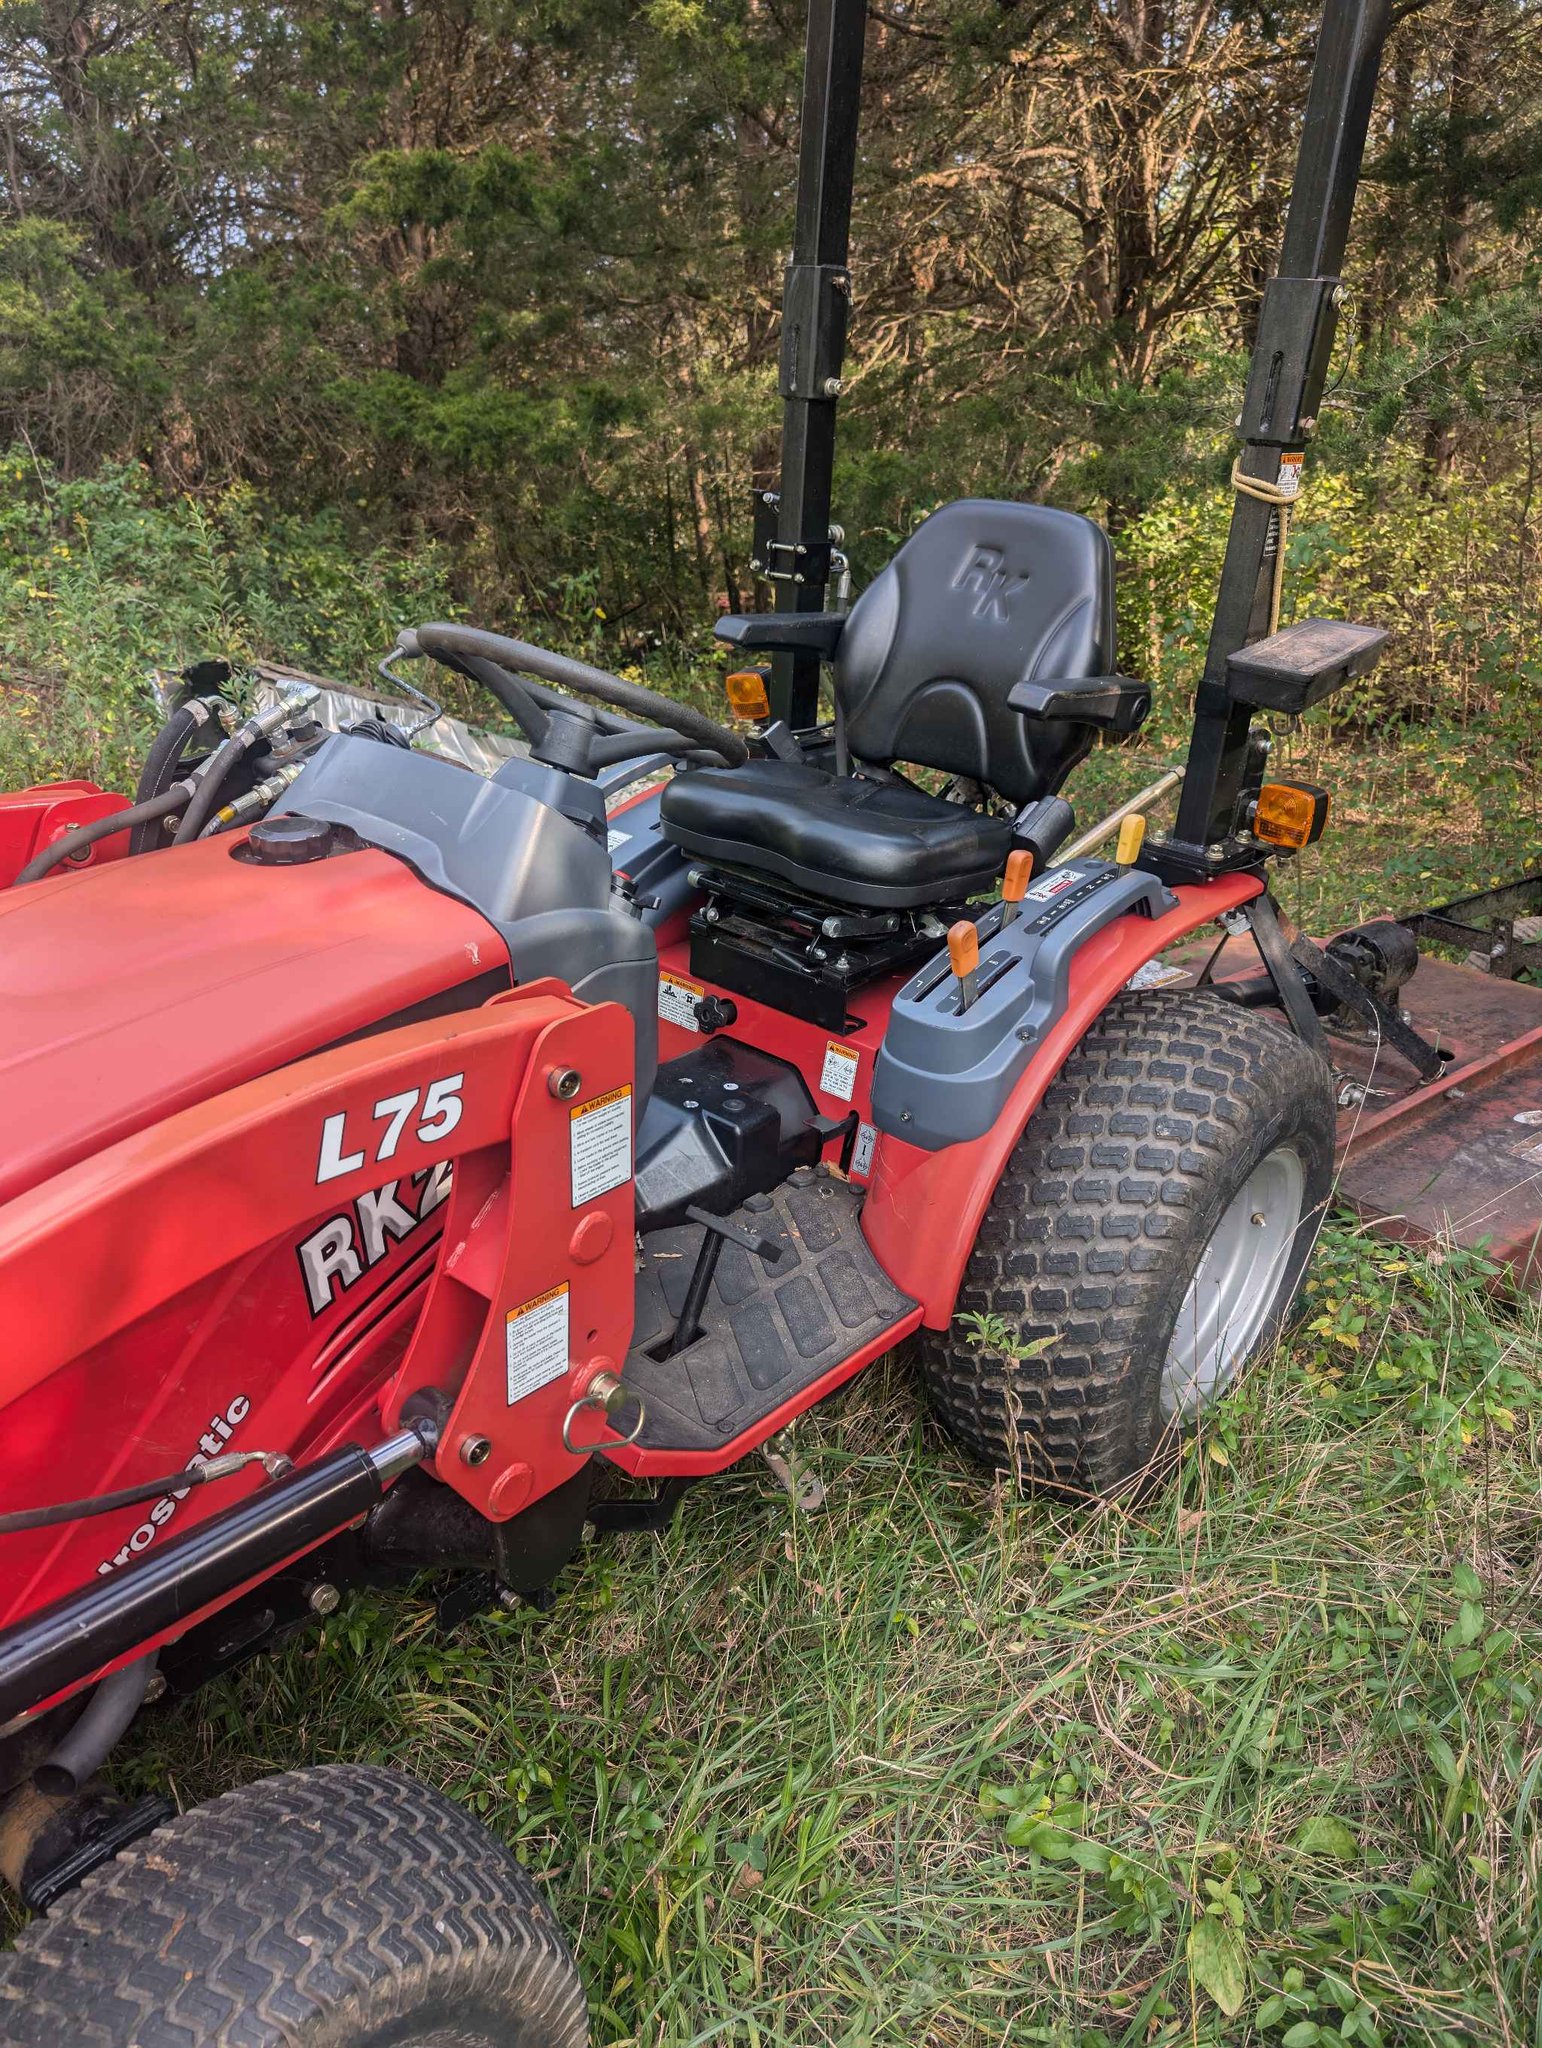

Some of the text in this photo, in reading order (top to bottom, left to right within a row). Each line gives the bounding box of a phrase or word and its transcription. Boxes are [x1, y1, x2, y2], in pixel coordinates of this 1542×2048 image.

[952, 543, 1030, 623] RK
[589, 1090, 622, 1111] WARNING
[525, 1288, 560, 1311] WARNING
